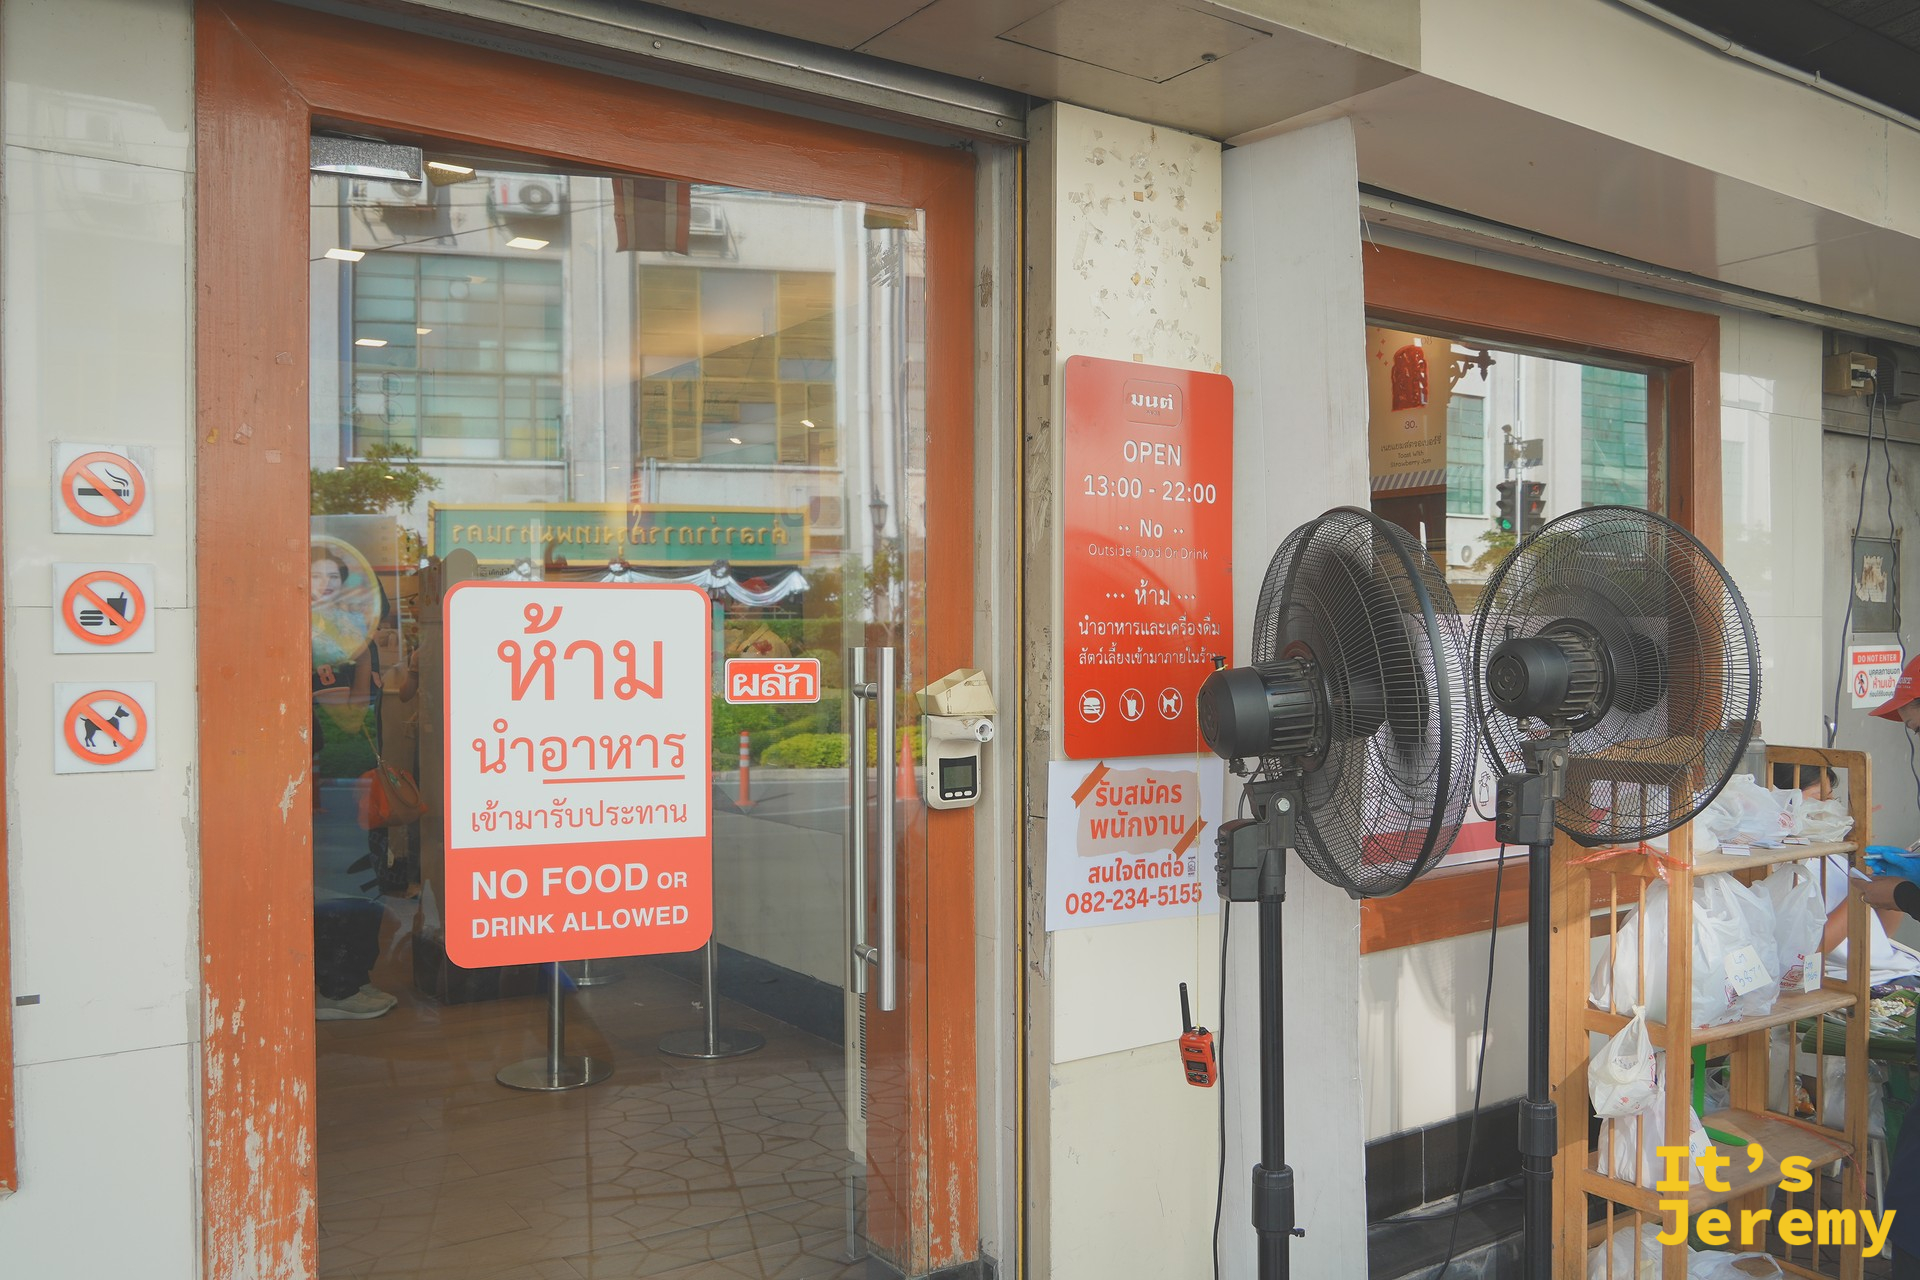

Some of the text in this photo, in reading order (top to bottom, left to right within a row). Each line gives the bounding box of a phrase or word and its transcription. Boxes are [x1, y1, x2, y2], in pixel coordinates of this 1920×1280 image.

[1123, 440, 1182, 467] OPEN
[1083, 474, 1143, 499] 13:00
[1162, 480, 1217, 504] 22:00
[1139, 519, 1164, 538] No
[1088, 543, 1209, 561] Outside Food Or Drink
[1134, 579, 1171, 606] ห้าม
[1078, 611, 1221, 636] นำอาหารและเครื่องดื่ม
[497, 602, 663, 701] ห้าม
[1078, 642, 1219, 665] สัตว์เลี้ยงเข้ามาภายในร้า
[1857, 653, 1897, 663] DO NOT ENTER
[732, 663, 814, 697] ผลัก
[472, 718, 687, 774] นำอาหาร
[1095, 778, 1183, 807] รับสมัคร
[471, 797, 688, 832] เข้ามารับประทาน
[1090, 810, 1185, 840] พนักงาน
[472, 863, 688, 901] NO FOOD OR
[1088, 854, 1185, 884] สนใจติดต่อ
[1065, 882, 1203, 915] 082-234-5155
[472, 905, 689, 939] DRINK ALLOWED
